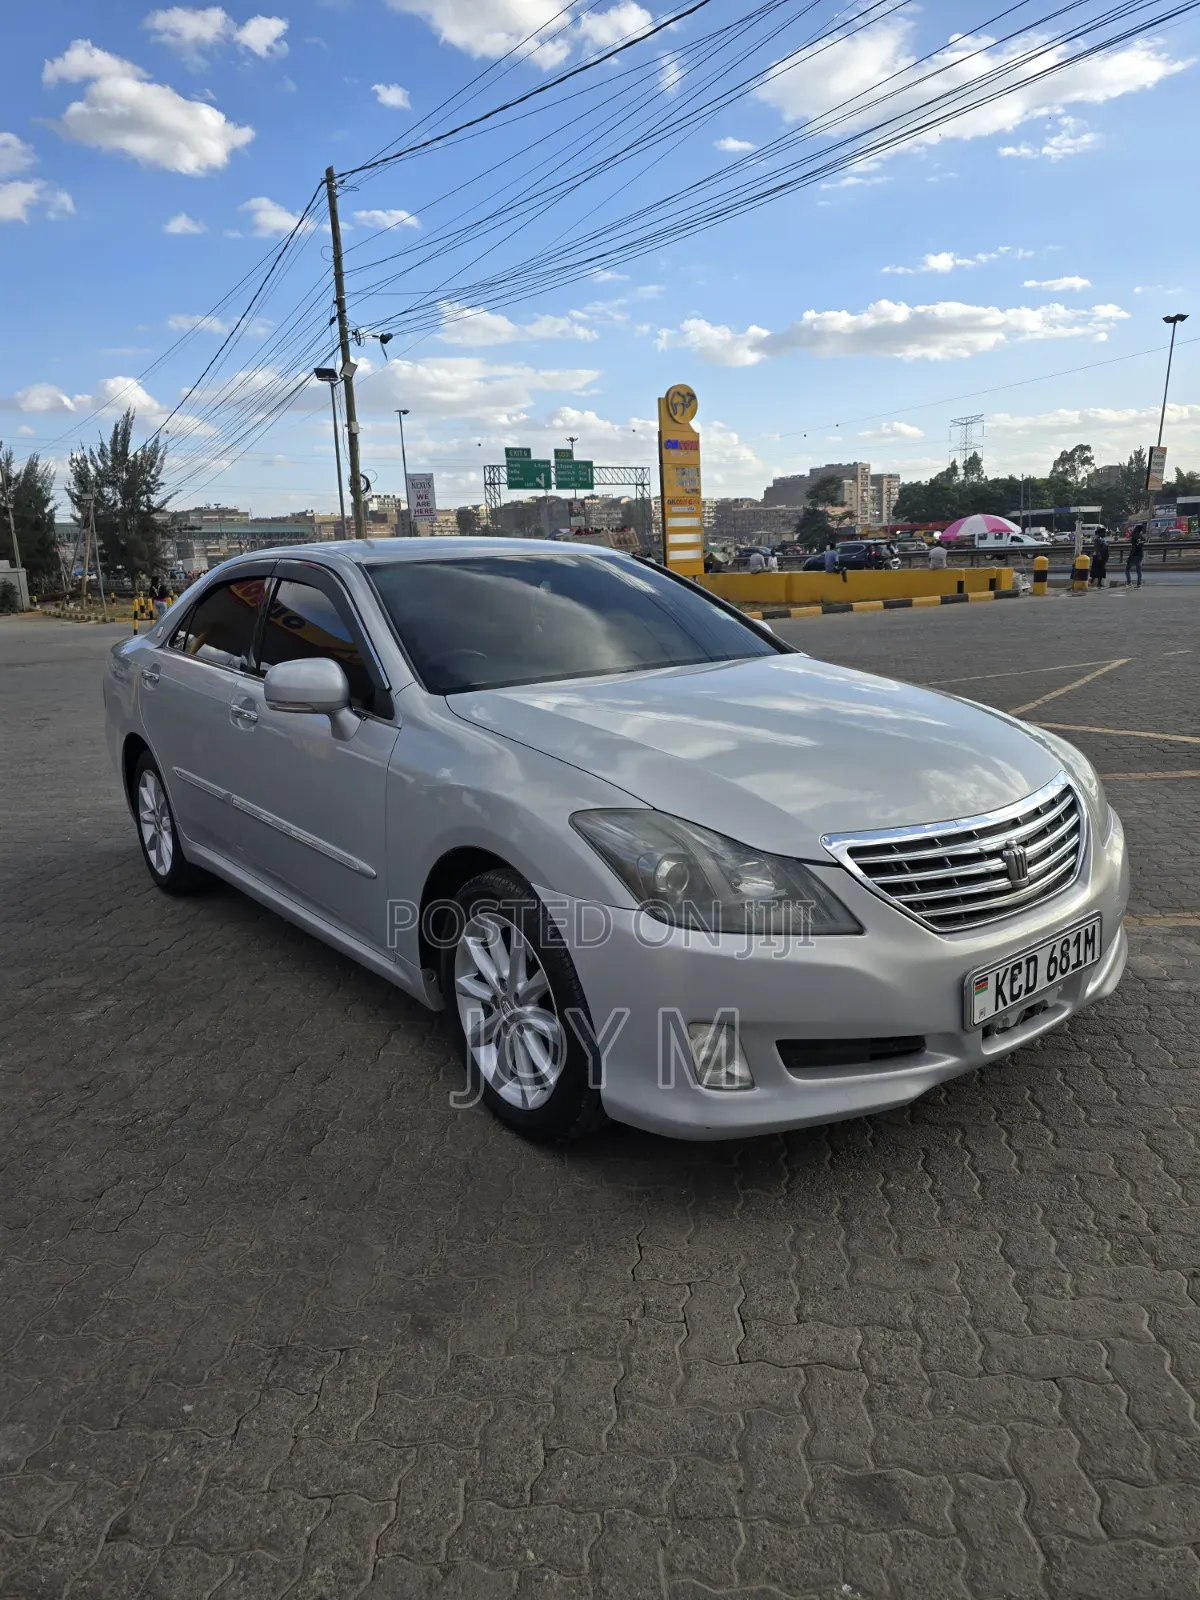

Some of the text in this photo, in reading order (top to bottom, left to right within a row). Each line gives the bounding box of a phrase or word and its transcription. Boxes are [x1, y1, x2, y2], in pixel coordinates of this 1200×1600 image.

[411, 481, 432, 490] NEXUS
[994, 924, 1096, 1012] KCD 681M
